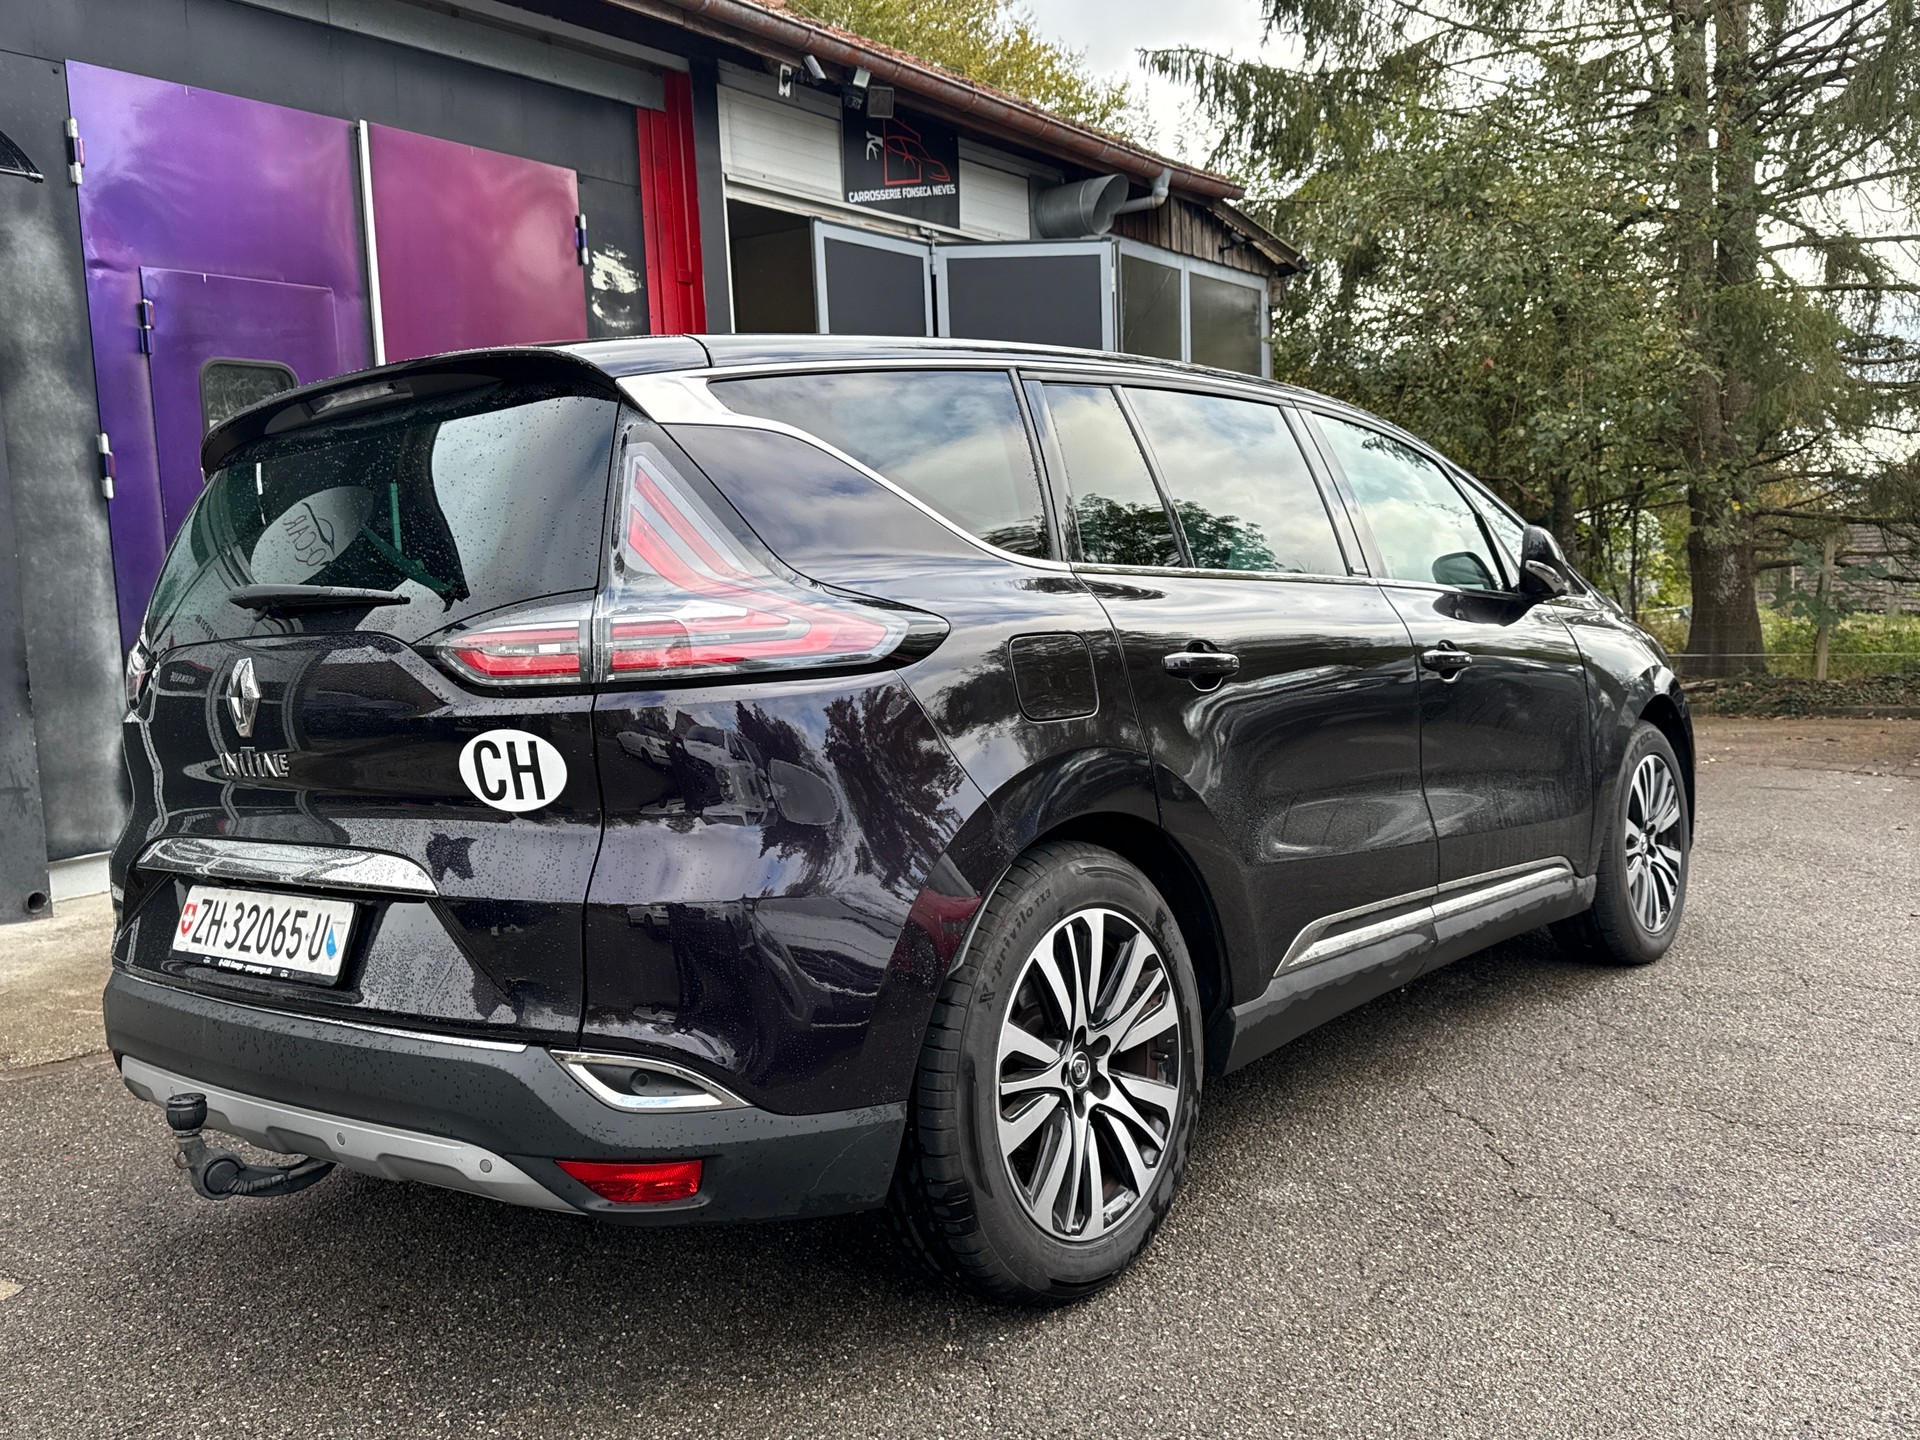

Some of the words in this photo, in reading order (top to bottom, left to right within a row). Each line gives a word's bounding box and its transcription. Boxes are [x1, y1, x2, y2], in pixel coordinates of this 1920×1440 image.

[848, 188, 902, 203] CARROSSERIE
[902, 186, 931, 199] FONSECA
[932, 184, 956, 196] NEVES
[473, 739, 546, 802] CH
